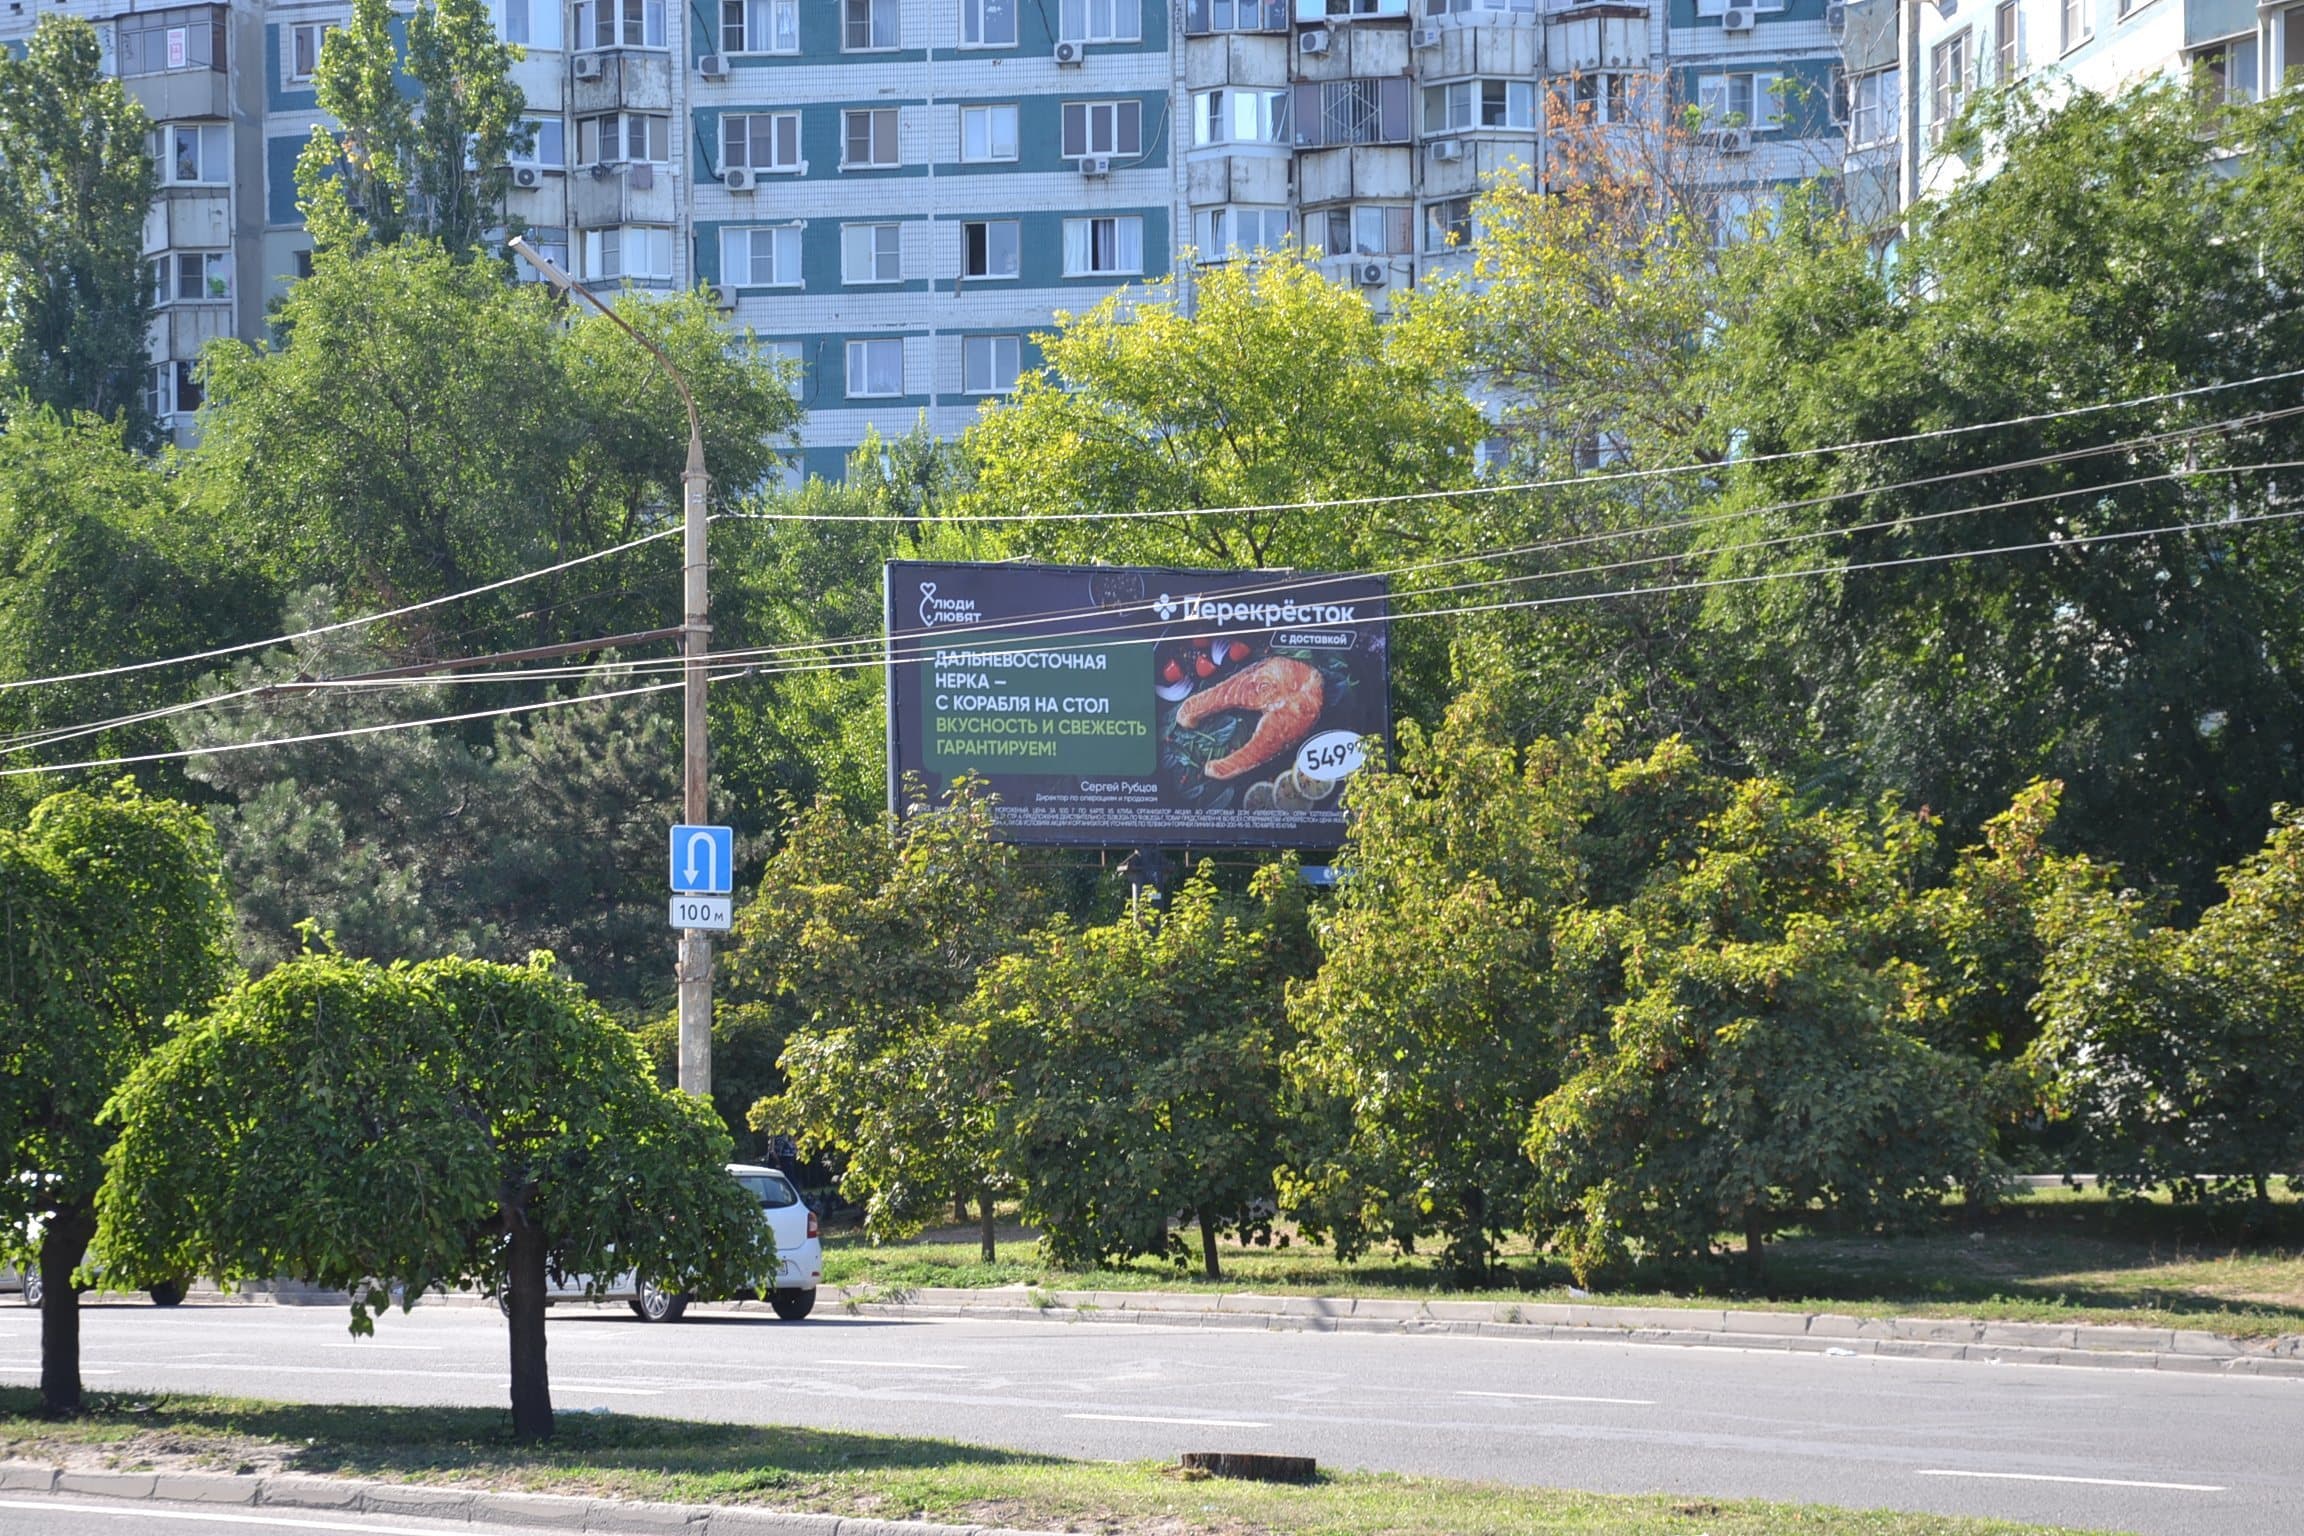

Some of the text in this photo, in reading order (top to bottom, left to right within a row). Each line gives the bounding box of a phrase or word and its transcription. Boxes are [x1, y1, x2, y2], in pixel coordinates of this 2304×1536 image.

[933, 599, 975, 611] ЛЮДИ
[1184, 597, 1355, 627] Перекрёсток
[932, 611, 982, 623] ЛЮБЯТ
[1289, 634, 1348, 645] доставкой
[934, 651, 1107, 670] ДАЛЬНЕВОСТОЧНАЯ
[935, 673, 990, 689] НЕРКА
[935, 695, 1109, 714] С КОРАБЛЯ НА СТОЛ
[936, 717, 1147, 736] ВКУСНОСТЬ И СВЕЖЕСТЬ
[936, 739, 1057, 756] ГАРАНТИРУЕМ!
[1080, 781, 1158, 794] Сергей Рубцов
[680, 904, 711, 921] 100
